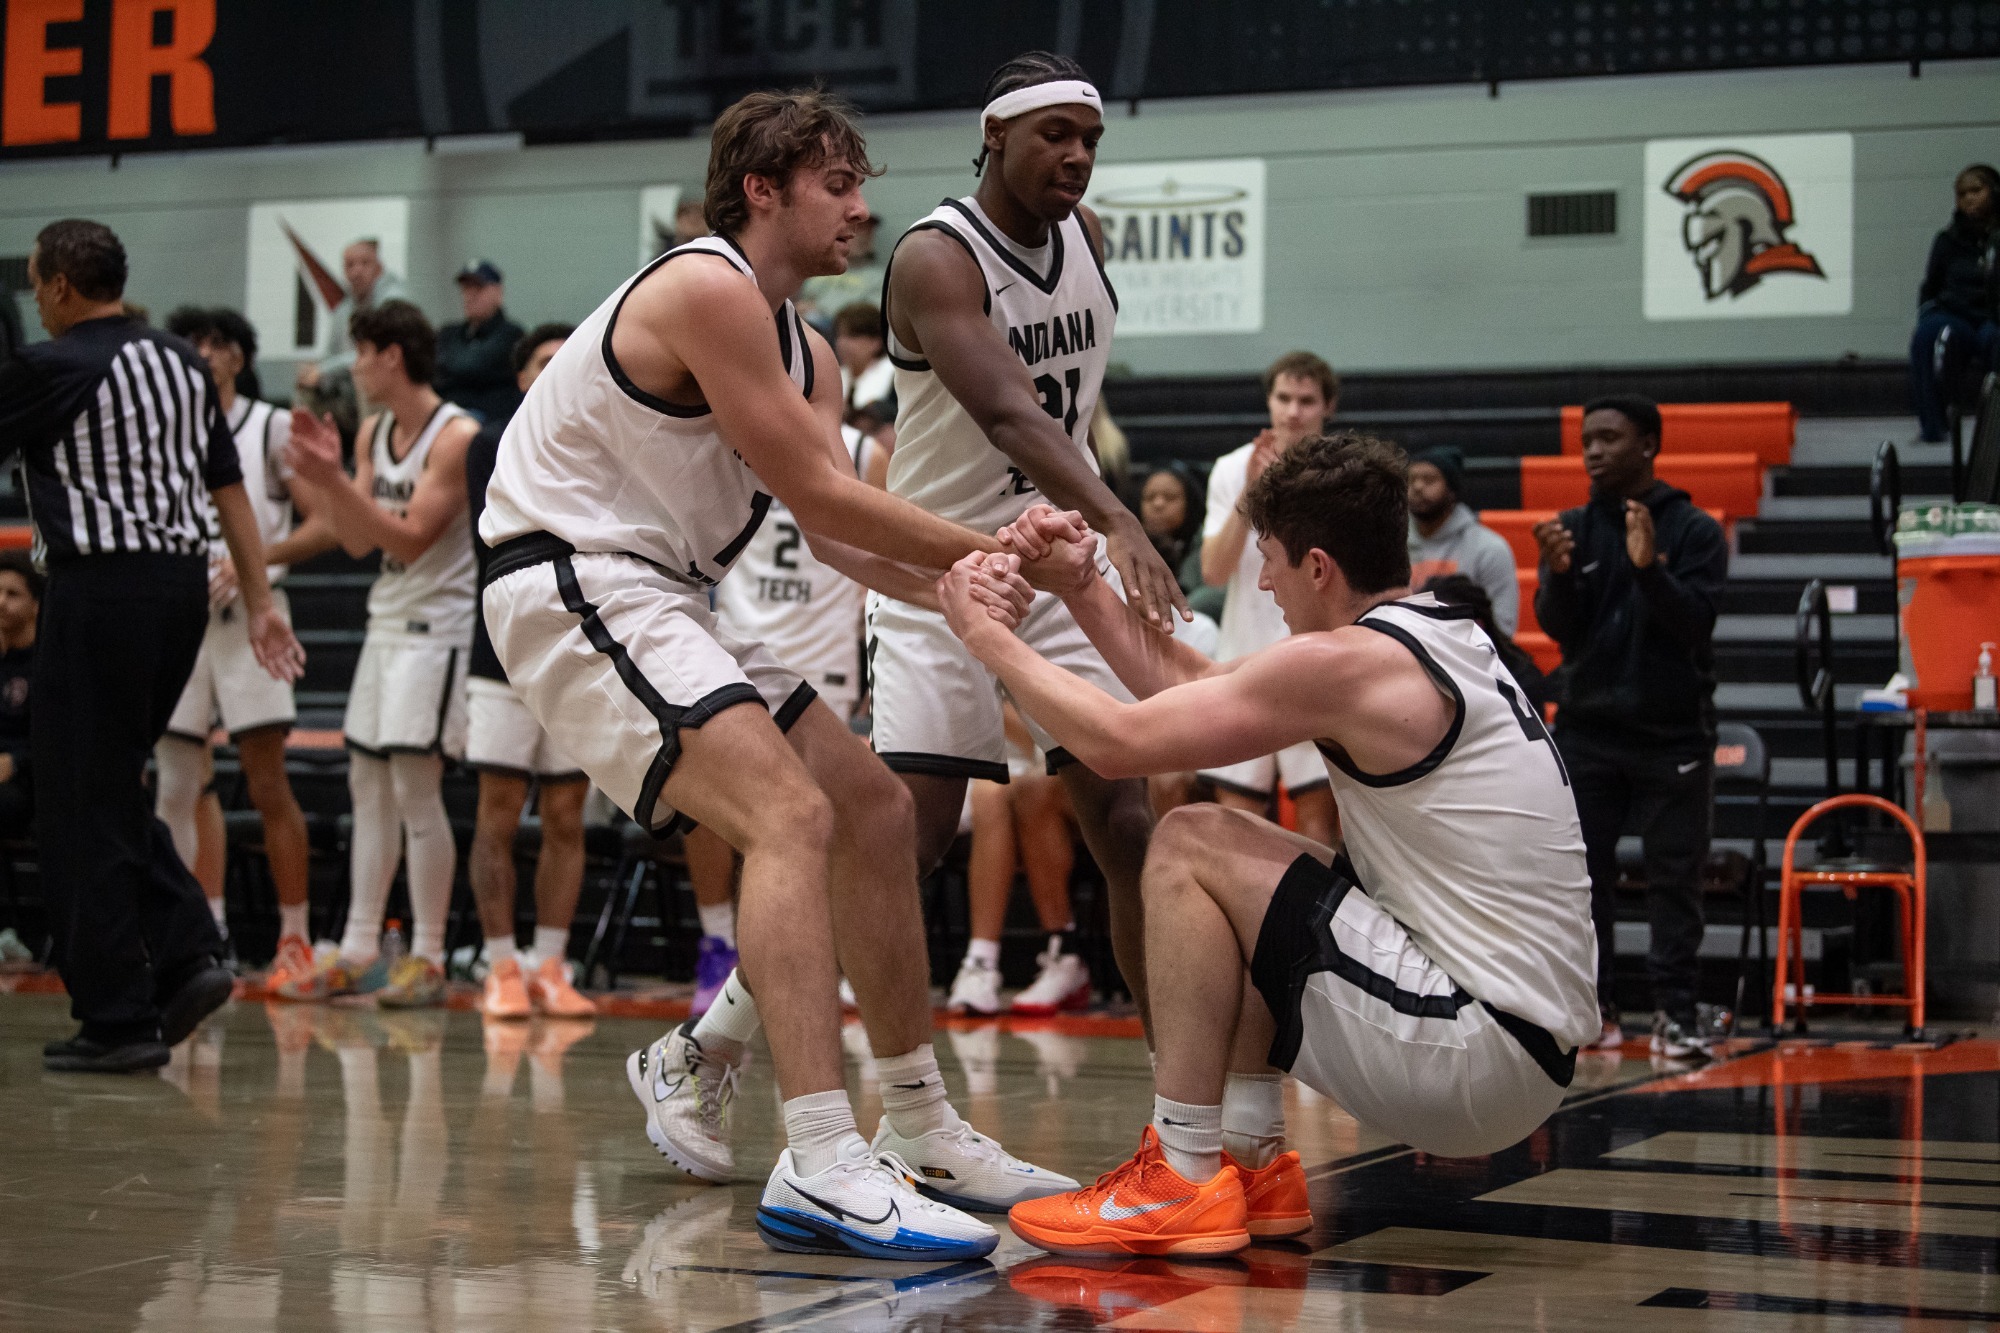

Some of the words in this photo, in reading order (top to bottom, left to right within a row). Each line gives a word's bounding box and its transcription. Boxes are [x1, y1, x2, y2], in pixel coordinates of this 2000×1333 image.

[3, 0, 217, 146] ER
[1099, 209, 1246, 262] SAINTS
[774, 522, 800, 569] 2
[756, 577, 812, 603] TECH
